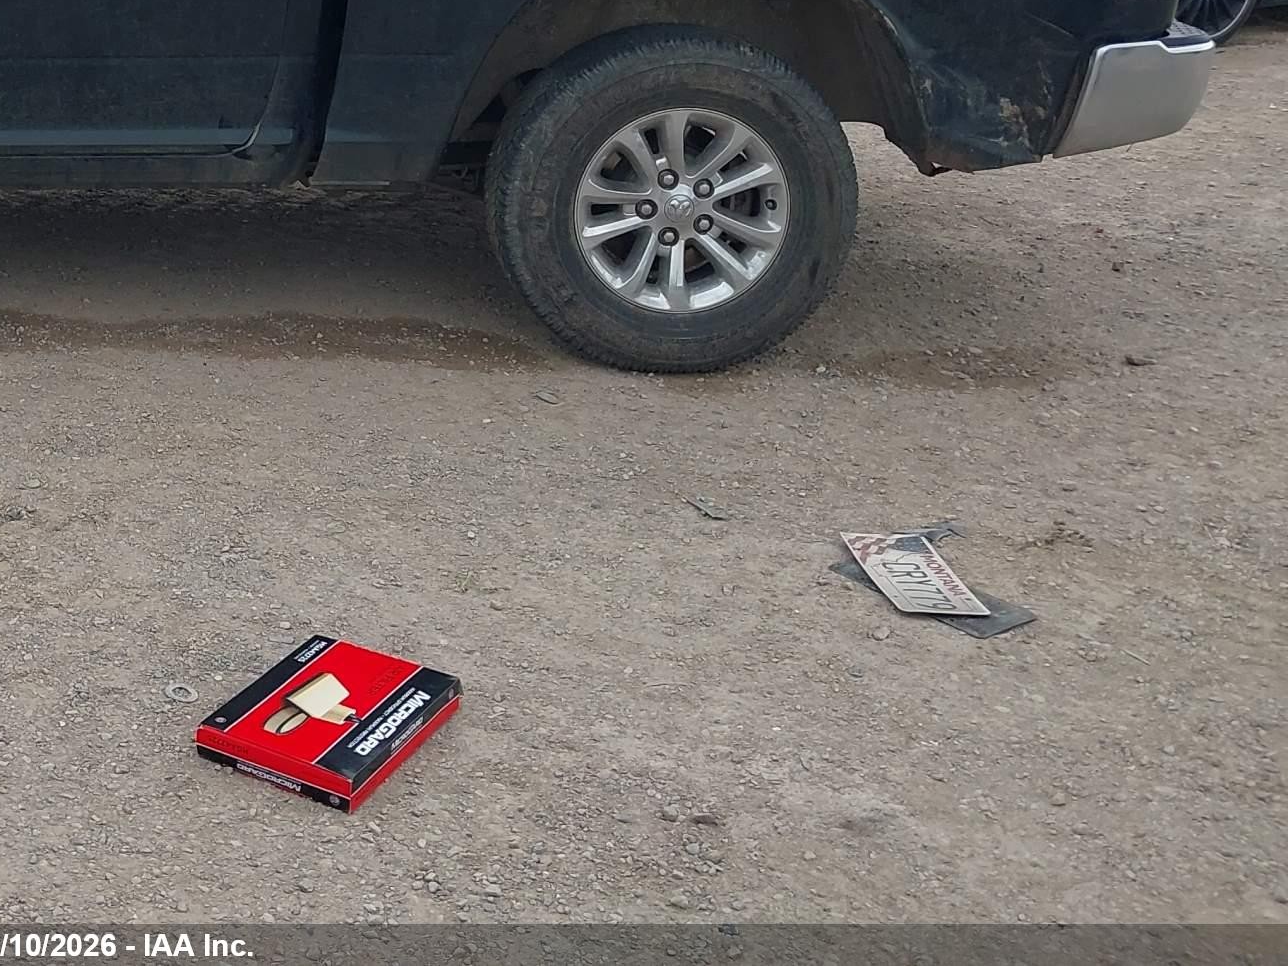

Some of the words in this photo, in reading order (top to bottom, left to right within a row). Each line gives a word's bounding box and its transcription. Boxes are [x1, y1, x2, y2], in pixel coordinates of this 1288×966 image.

[881, 562, 957, 610] CRY779
[919, 554, 967, 597] MONTANA
[353, 690, 432, 756] MICROGARD
[236, 763, 302, 792] MICROGARD
